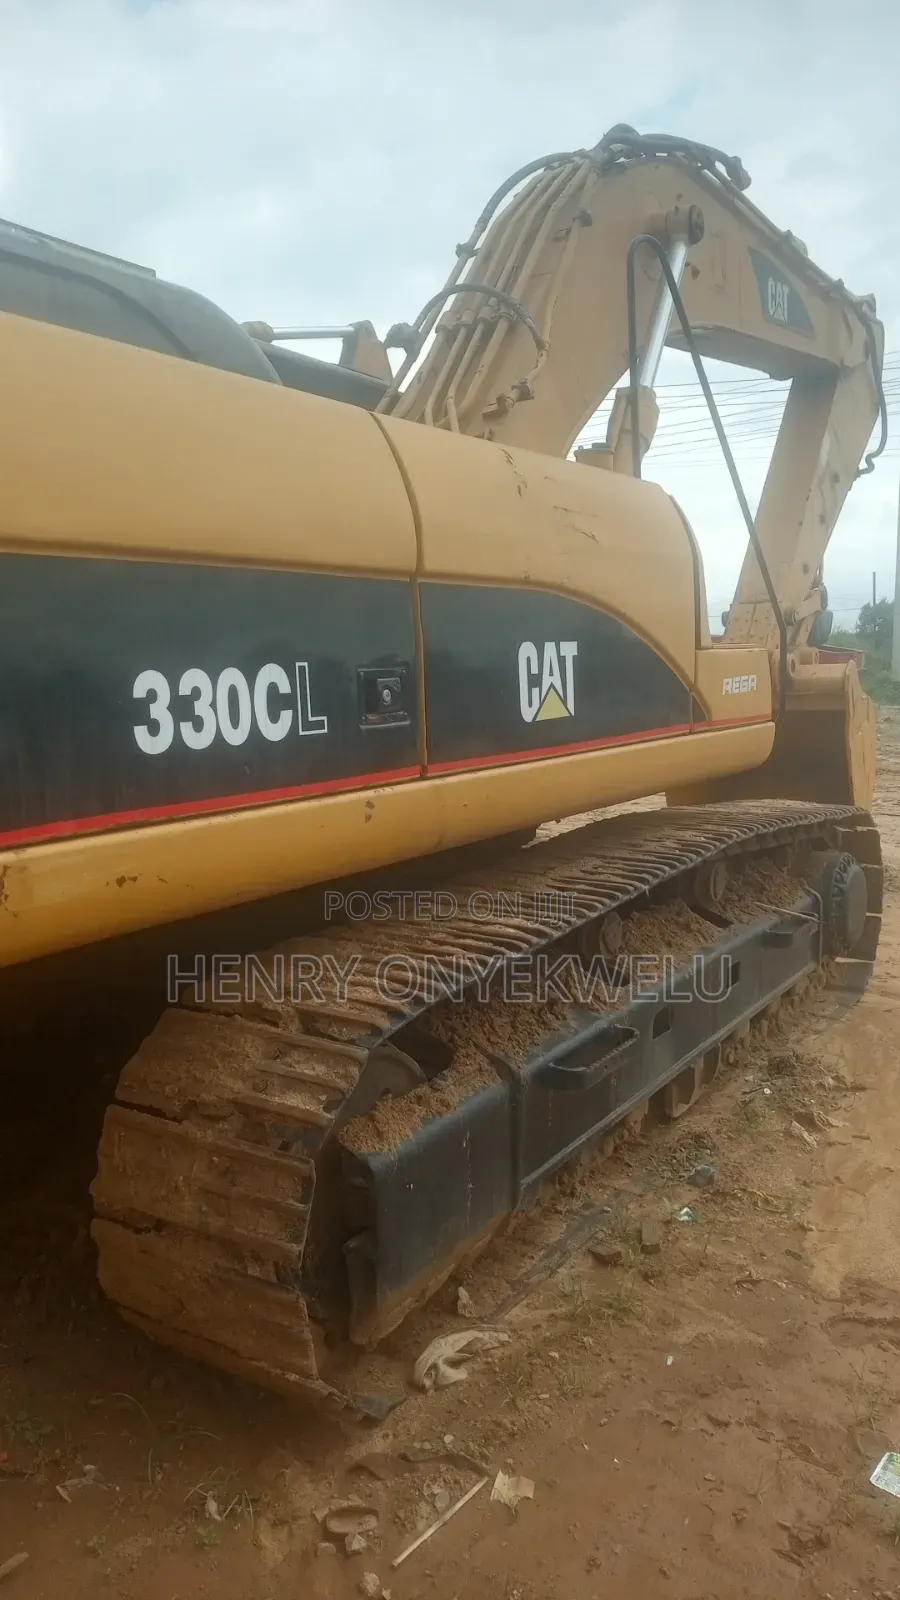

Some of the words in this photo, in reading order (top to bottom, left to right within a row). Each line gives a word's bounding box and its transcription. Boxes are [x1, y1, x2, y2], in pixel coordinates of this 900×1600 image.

[767, 276, 789, 323] CAT
[132, 661, 328, 755] 330CL
[517, 640, 579, 723] CAT
